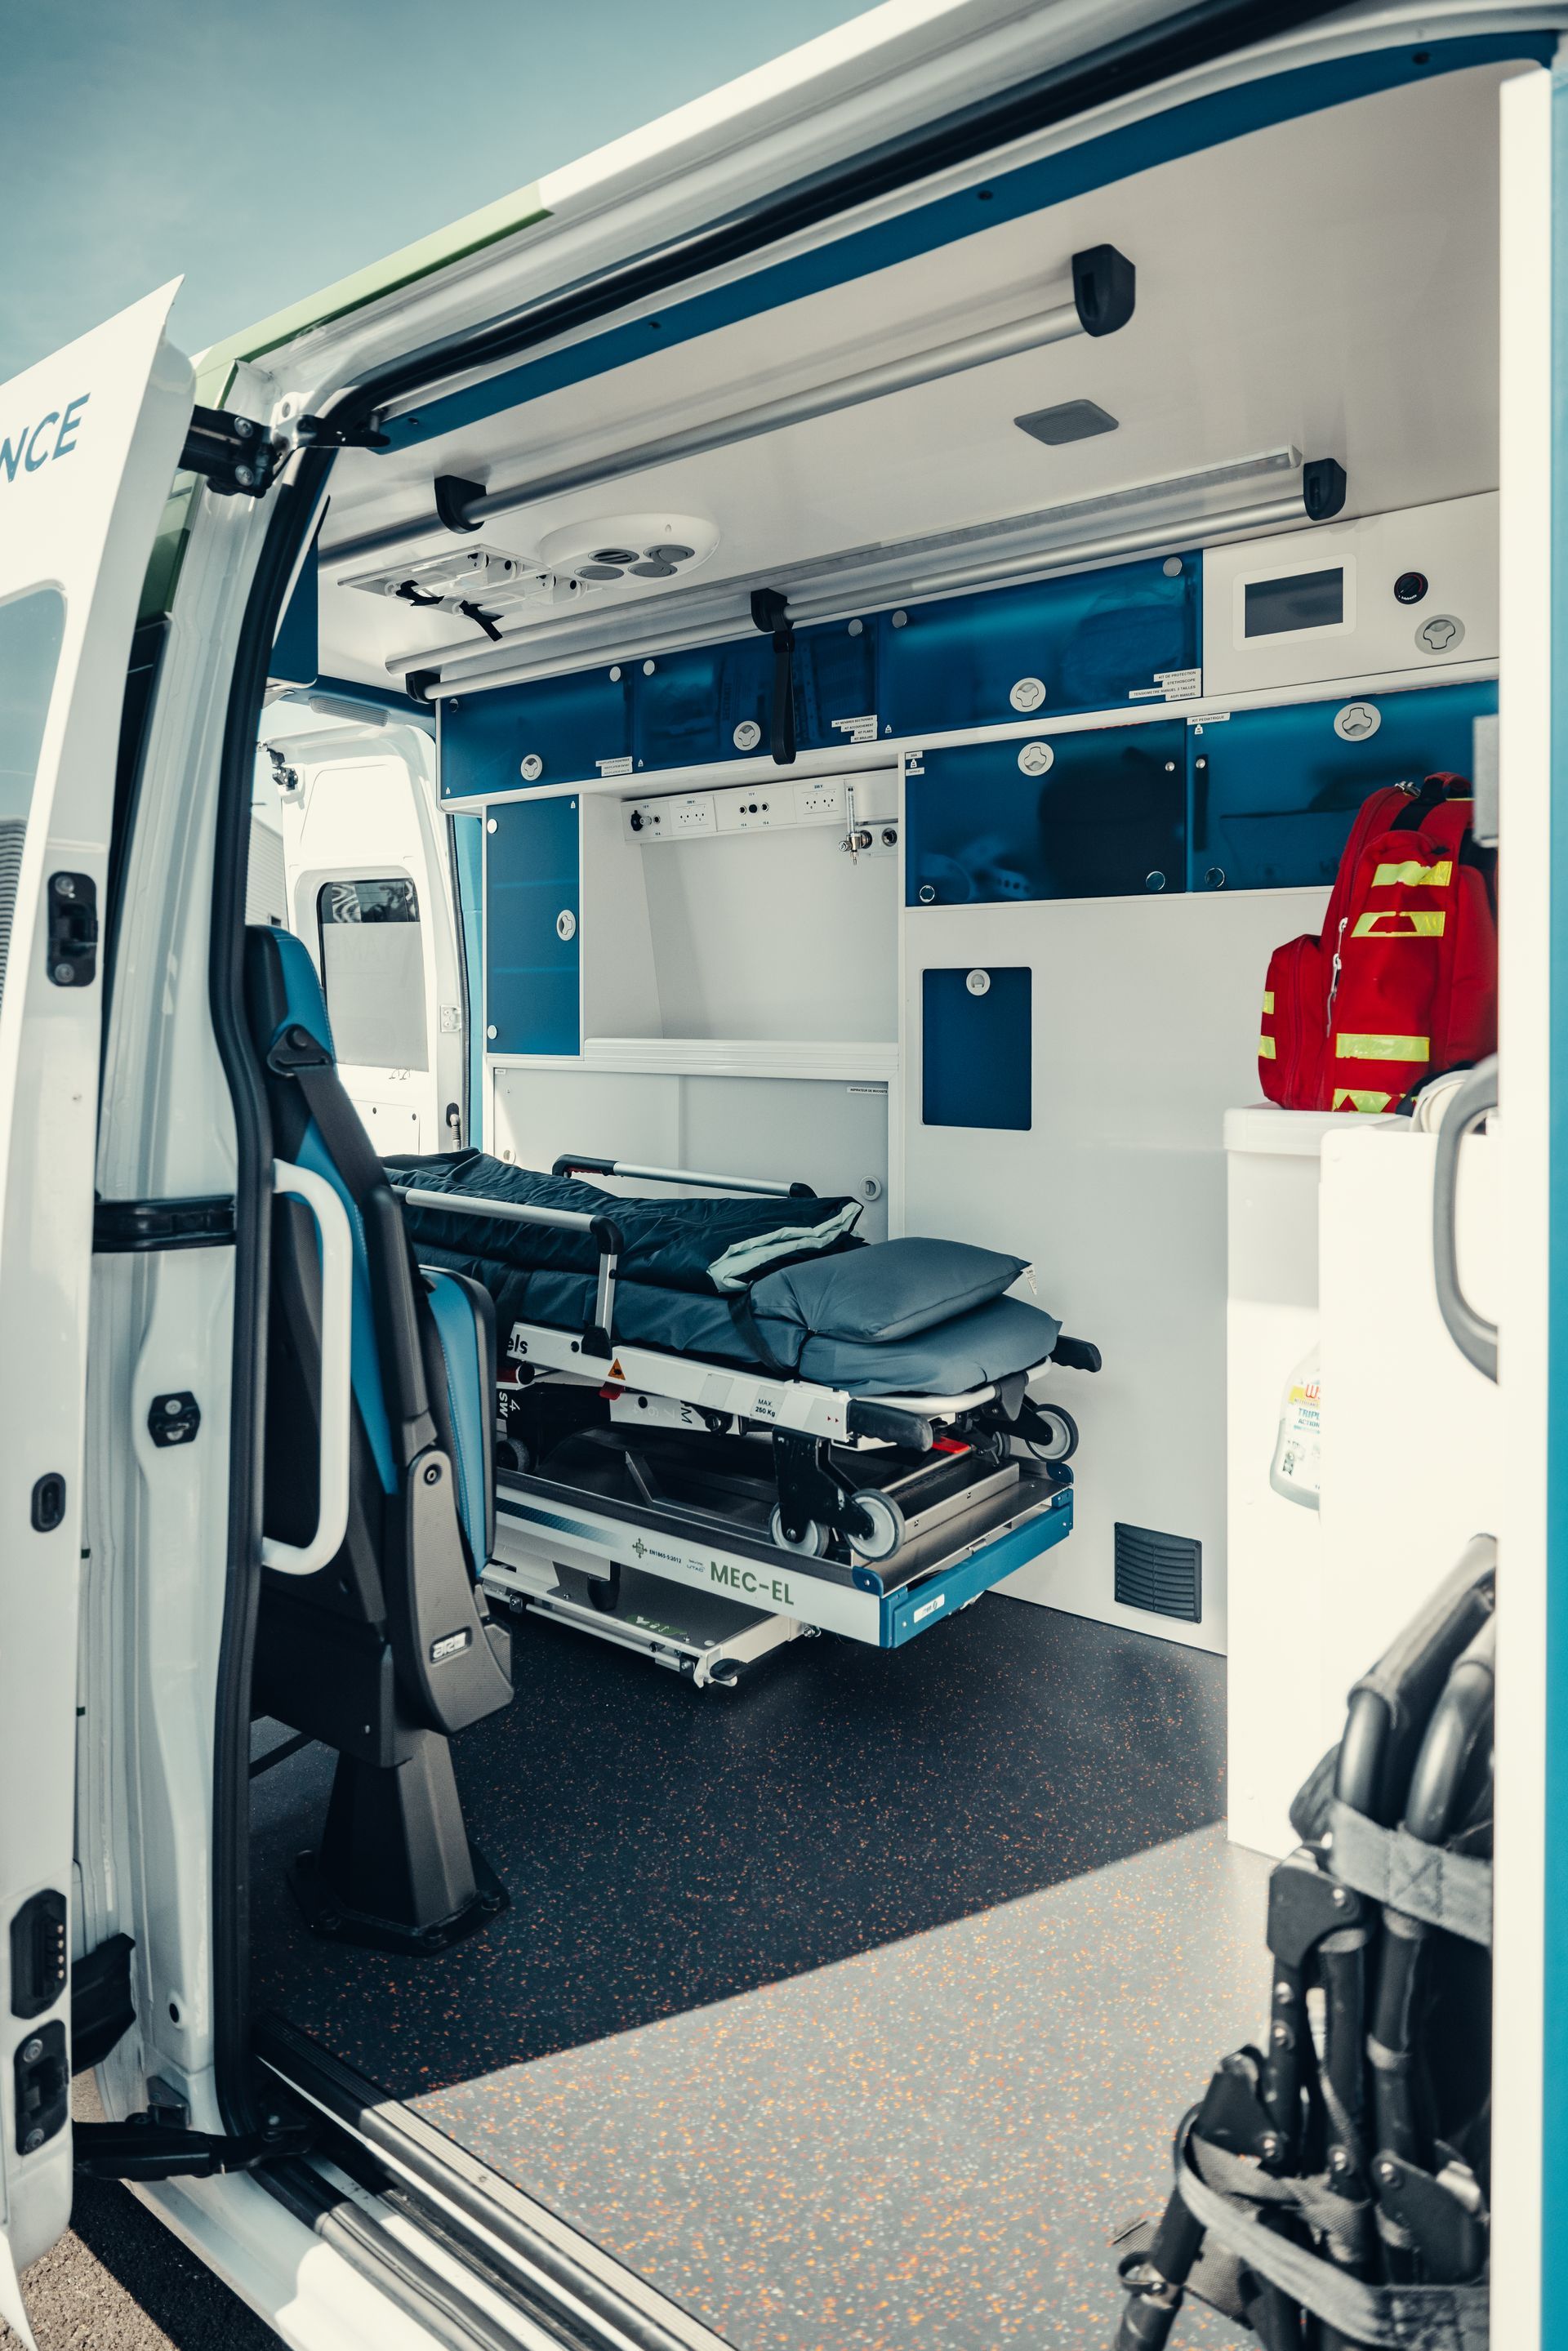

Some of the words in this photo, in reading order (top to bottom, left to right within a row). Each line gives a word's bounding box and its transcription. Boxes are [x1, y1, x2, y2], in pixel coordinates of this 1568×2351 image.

[0, 391, 91, 483] NCE
[755, 1406, 767, 1414] 250
[767, 1407, 776, 1418] Kg
[710, 1561, 795, 1605] MEC-EL
